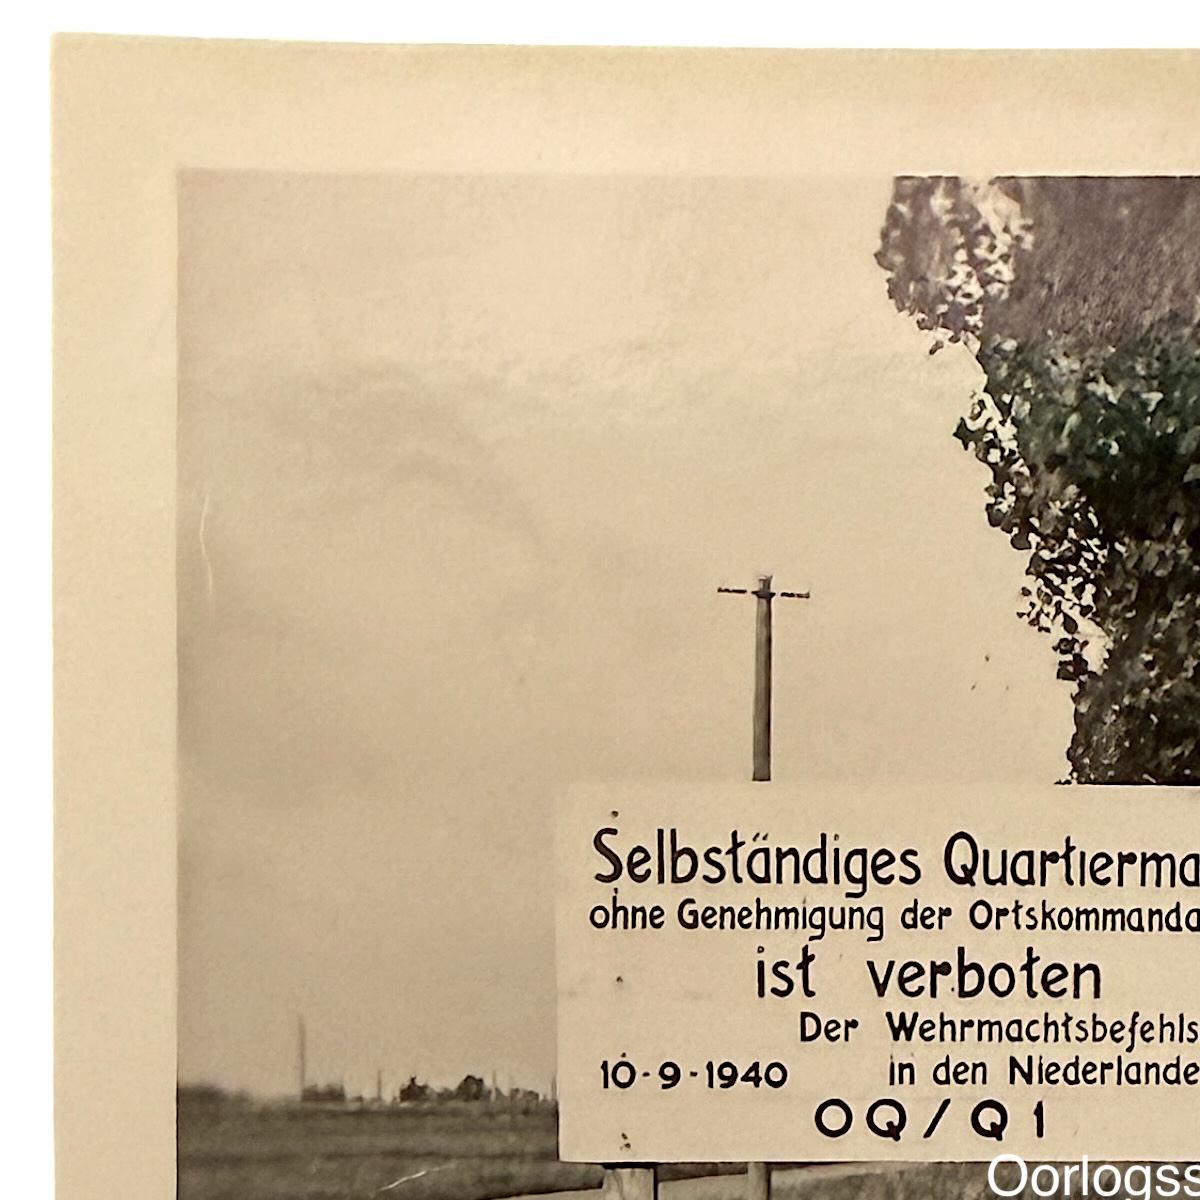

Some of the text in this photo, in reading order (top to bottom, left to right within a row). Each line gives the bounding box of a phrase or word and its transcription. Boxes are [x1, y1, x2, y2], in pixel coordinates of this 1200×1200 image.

[593, 827, 922, 899] Selbständiges
[589, 895, 665, 930] ohne
[677, 897, 884, 943] Genehmigung
[900, 898, 954, 931] der
[756, 944, 1101, 1000] ist verboten
[800, 1011, 860, 1043] Der
[889, 1054, 916, 1087] in
[932, 1054, 988, 1086] den
